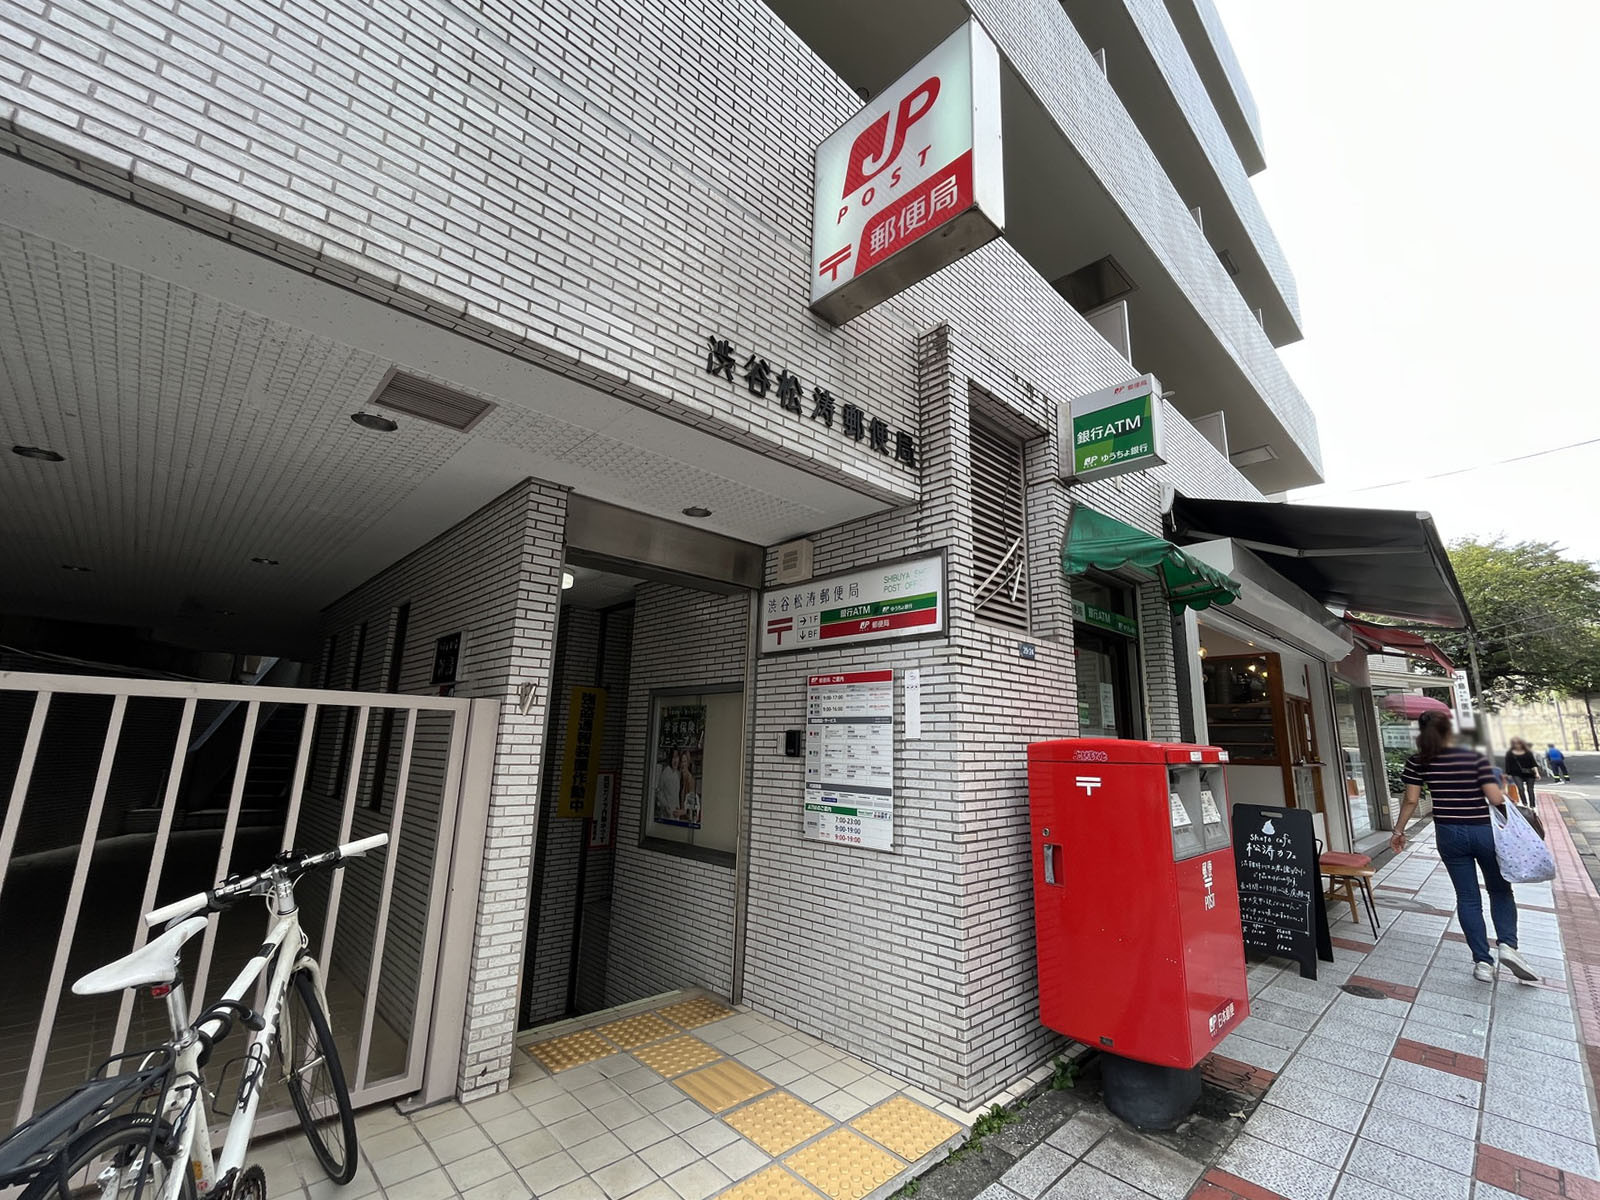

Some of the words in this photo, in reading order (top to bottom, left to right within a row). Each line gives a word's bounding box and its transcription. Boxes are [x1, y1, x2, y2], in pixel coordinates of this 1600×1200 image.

[836, 145, 932, 225] POST
[869, 174, 958, 257] 郵便局
[706, 335, 916, 469] 渋谷松涛郵便局
[1077, 415, 1141, 445] 銀行ATM
[1101, 443, 1148, 463] ゆうちょ銀行
[883, 571, 910, 584] SHIBUYA
[768, 582, 860, 614] 渋谷松涛郵便局
[883, 583, 900, 593] POST
[808, 615, 819, 624] 1F
[840, 605, 871, 618] 銀行ATM
[1204, 893, 1215, 911] POST
